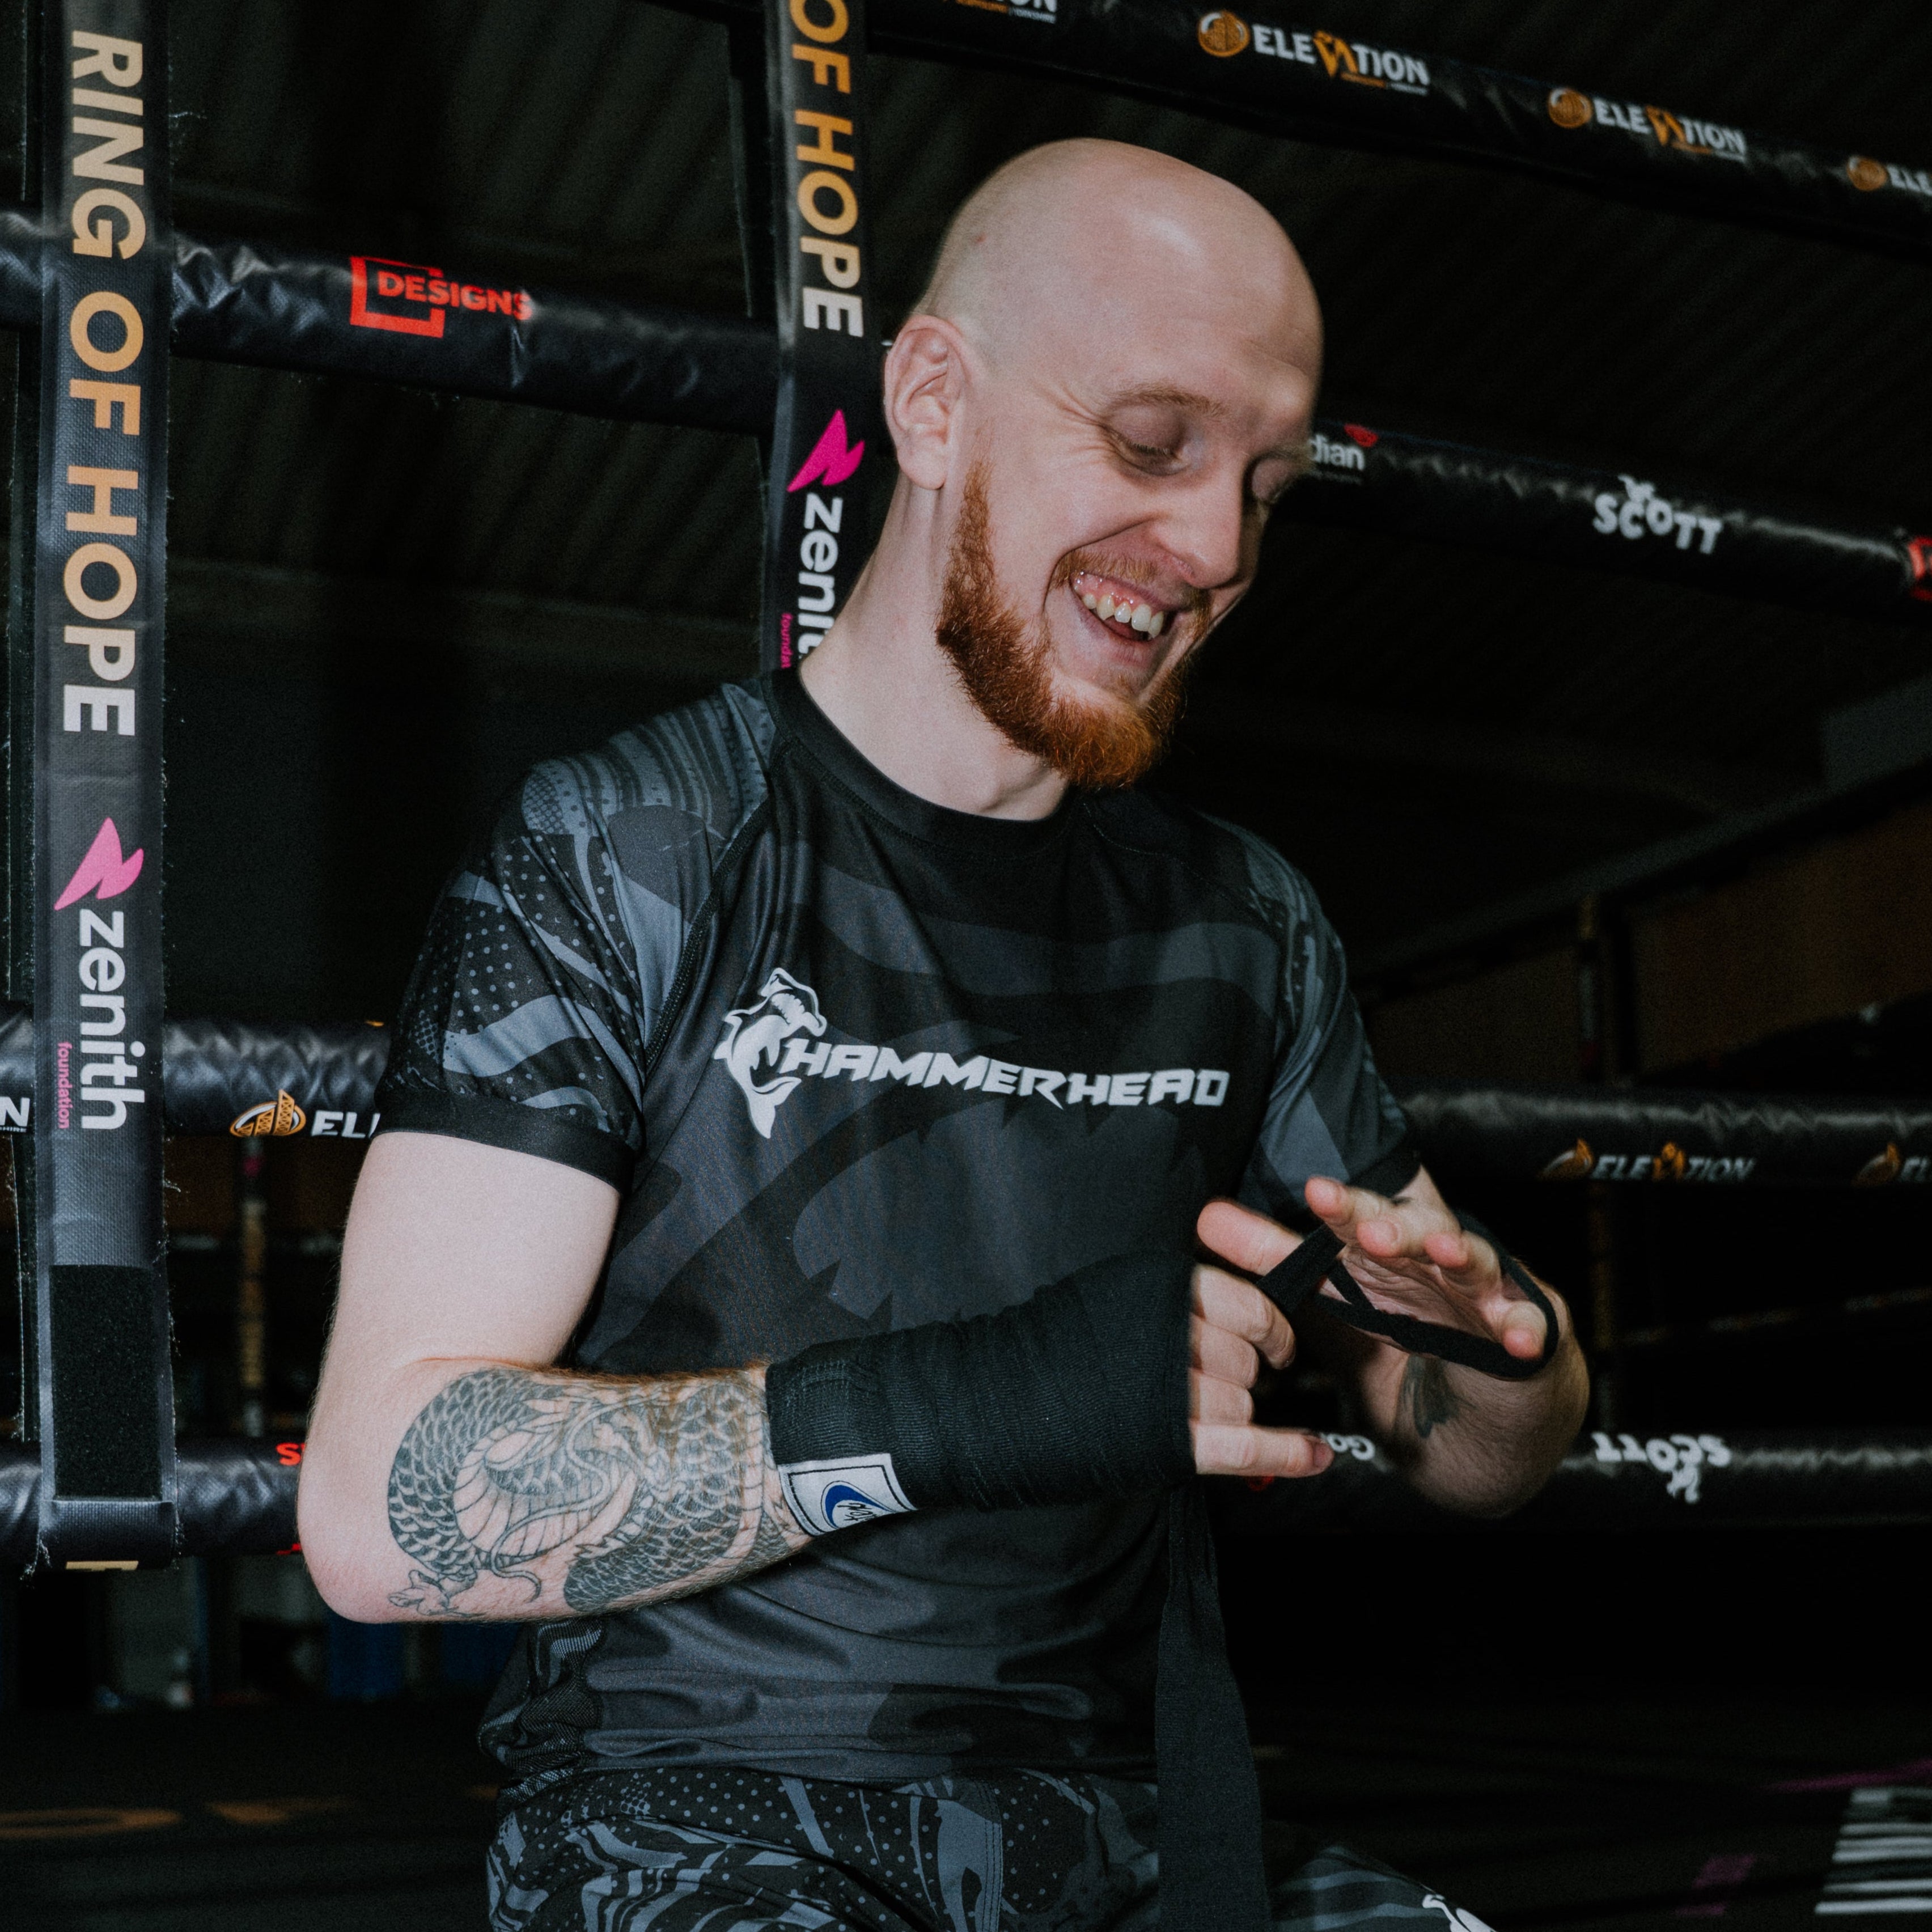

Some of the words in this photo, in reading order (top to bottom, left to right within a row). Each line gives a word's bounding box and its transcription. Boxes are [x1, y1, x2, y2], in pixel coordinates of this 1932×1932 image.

[790, 0, 850, 94] OF
[71, 30, 146, 260] RING
[795, 109, 864, 338] HOPE
[69, 291, 143, 436] OF
[63, 465, 138, 736] HOPE
[798, 492, 844, 660] zenit
[1592, 492, 1724, 555] SCOTT
[57, 1041, 74, 1129] foundation
[78, 909, 146, 1130] zenith
[777, 1038, 1231, 1111] HAMMERHEAD
